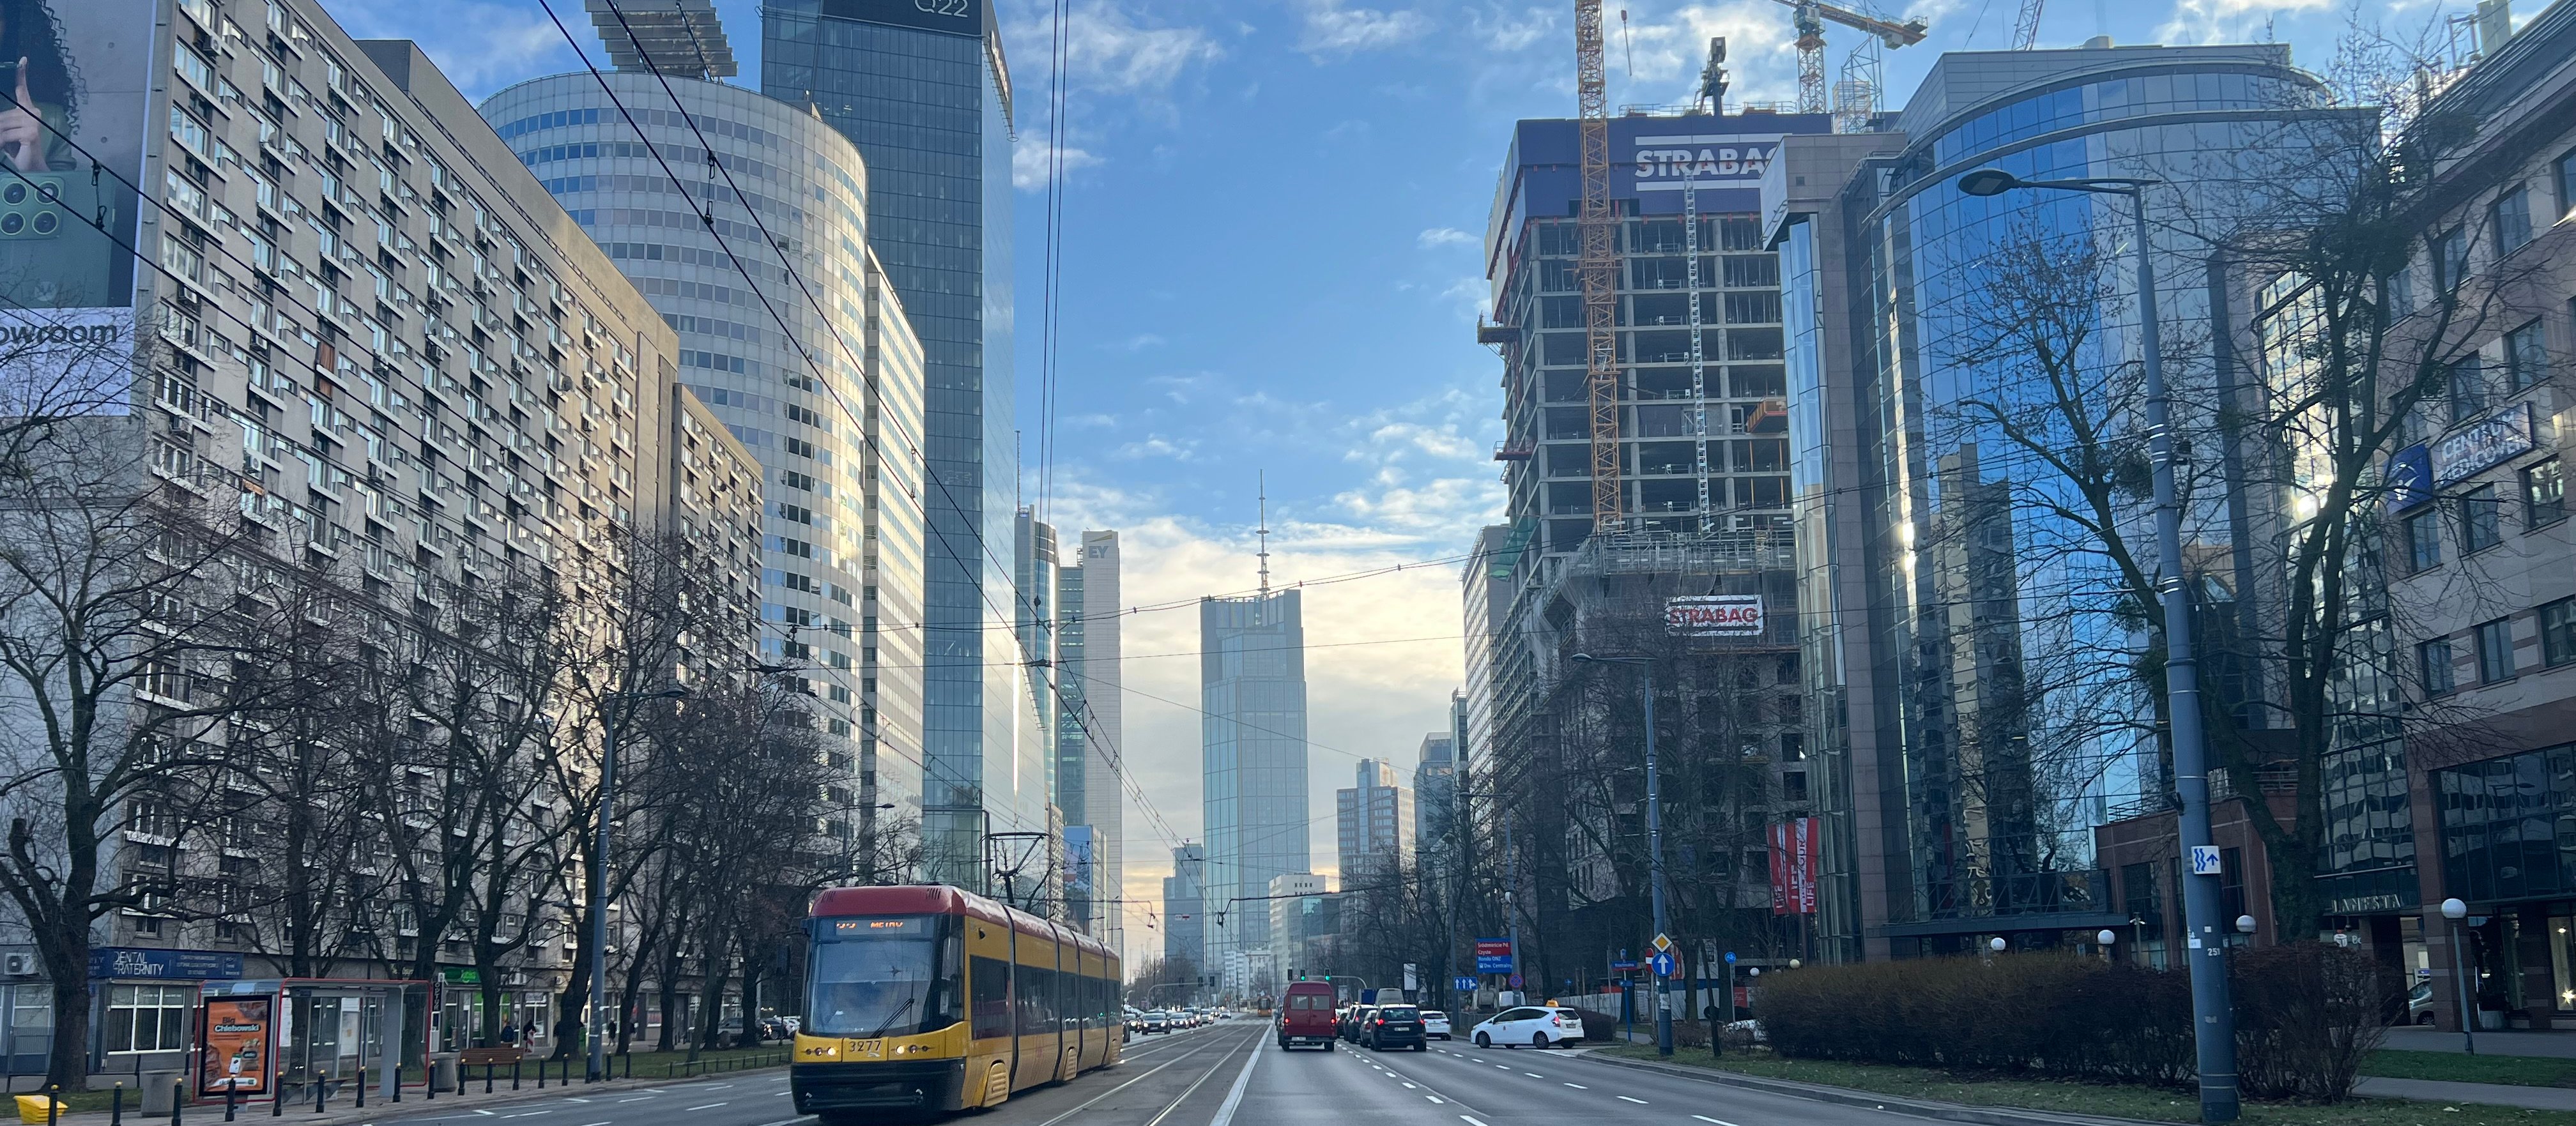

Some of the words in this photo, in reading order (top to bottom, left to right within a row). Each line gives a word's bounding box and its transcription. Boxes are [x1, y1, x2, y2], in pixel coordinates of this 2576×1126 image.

[915, 0, 968, 18] Q22
[1088, 545, 1108, 558] EY
[1669, 607, 1758, 624] STRABAG
[2207, 948, 2221, 956] 251
[112, 962, 164, 975] FRATERNITY
[848, 1040, 881, 1053] 3277
